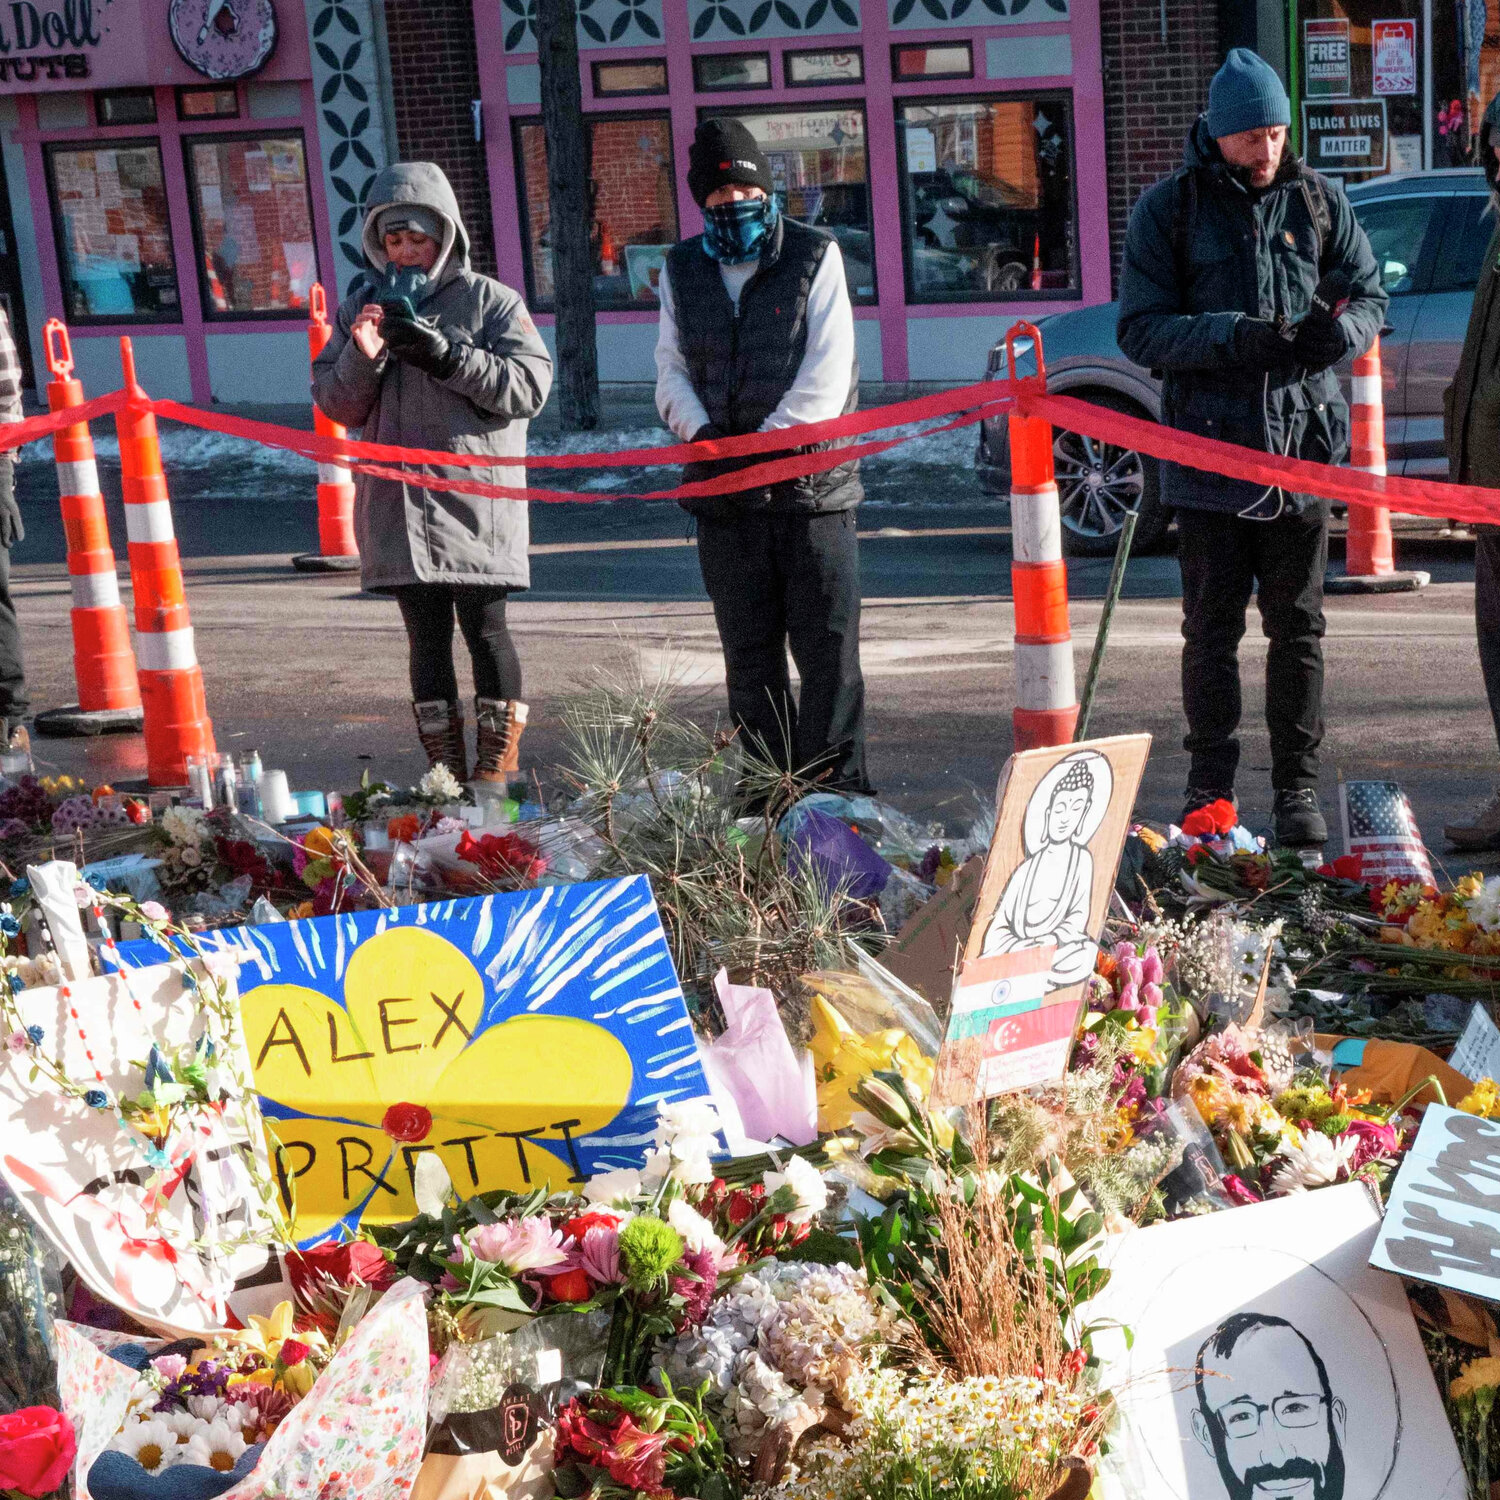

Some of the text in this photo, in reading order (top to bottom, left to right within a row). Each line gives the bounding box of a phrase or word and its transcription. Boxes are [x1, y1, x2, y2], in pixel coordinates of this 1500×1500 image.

[1309, 42, 1347, 61] FREE
[1308, 63, 1347, 74] PALESTINE
[1309, 113, 1381, 130] BLACK LIVES
[1324, 140, 1367, 153] MATTER
[256, 990, 475, 1076] ALEX
[274, 1119, 592, 1216] PRETTI
